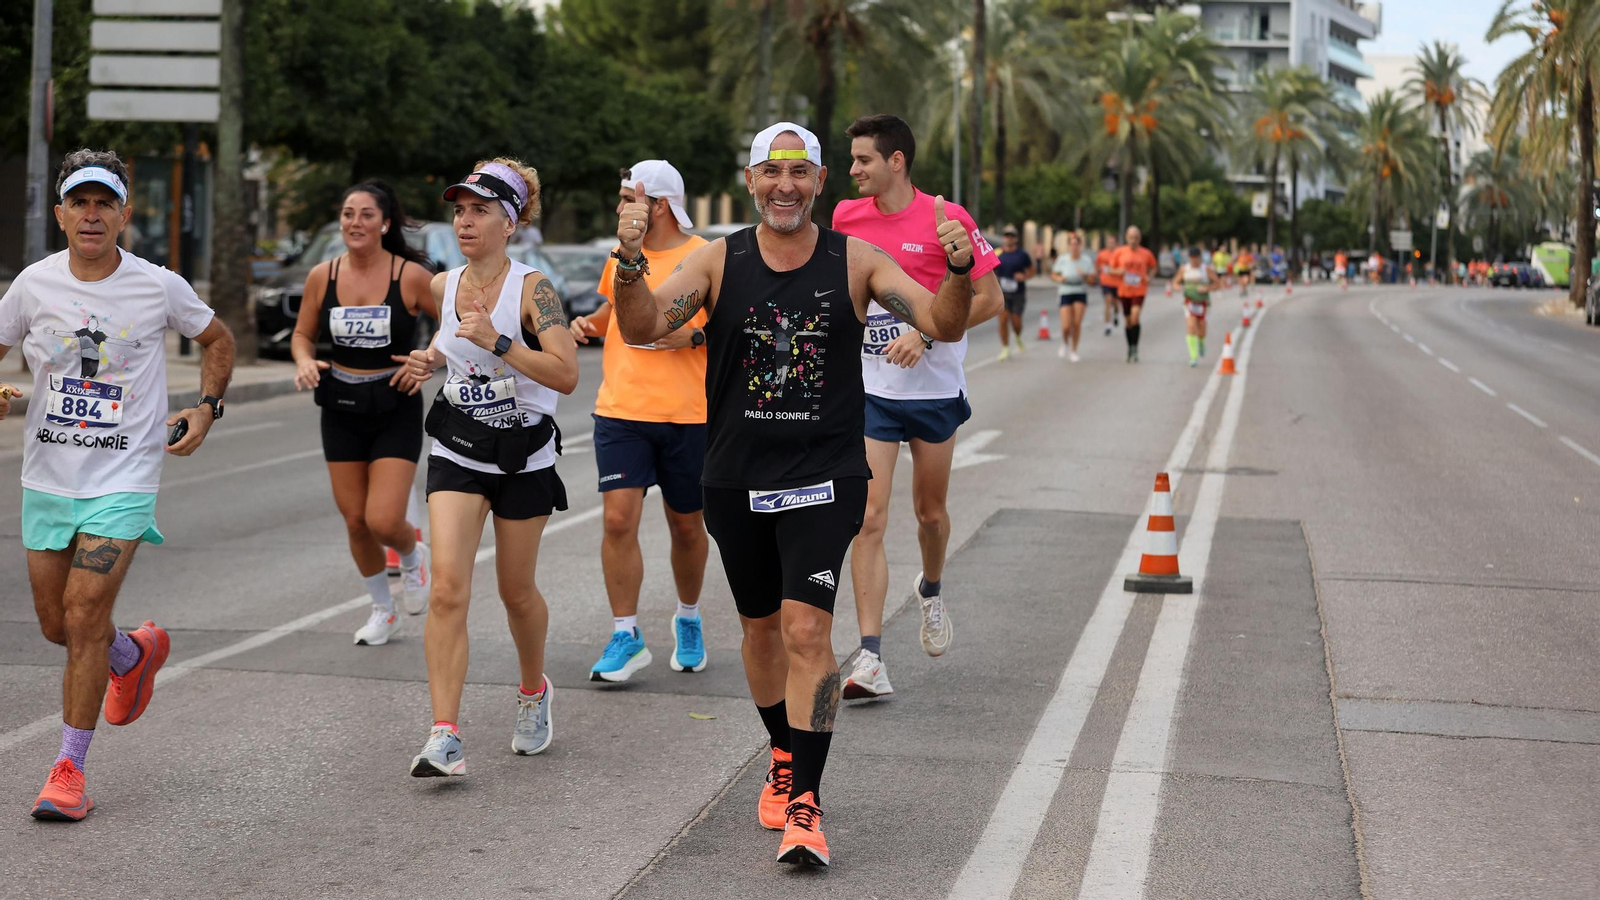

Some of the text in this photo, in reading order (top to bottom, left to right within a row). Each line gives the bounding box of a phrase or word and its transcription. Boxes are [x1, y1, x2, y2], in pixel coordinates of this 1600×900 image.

[345, 321, 375, 335] 724
[869, 326, 901, 343] 880
[458, 383, 496, 403] 886
[61, 396, 102, 419] 884
[744, 409, 810, 420] PABLO SONRIE
[34, 427, 68, 445] ABLO
